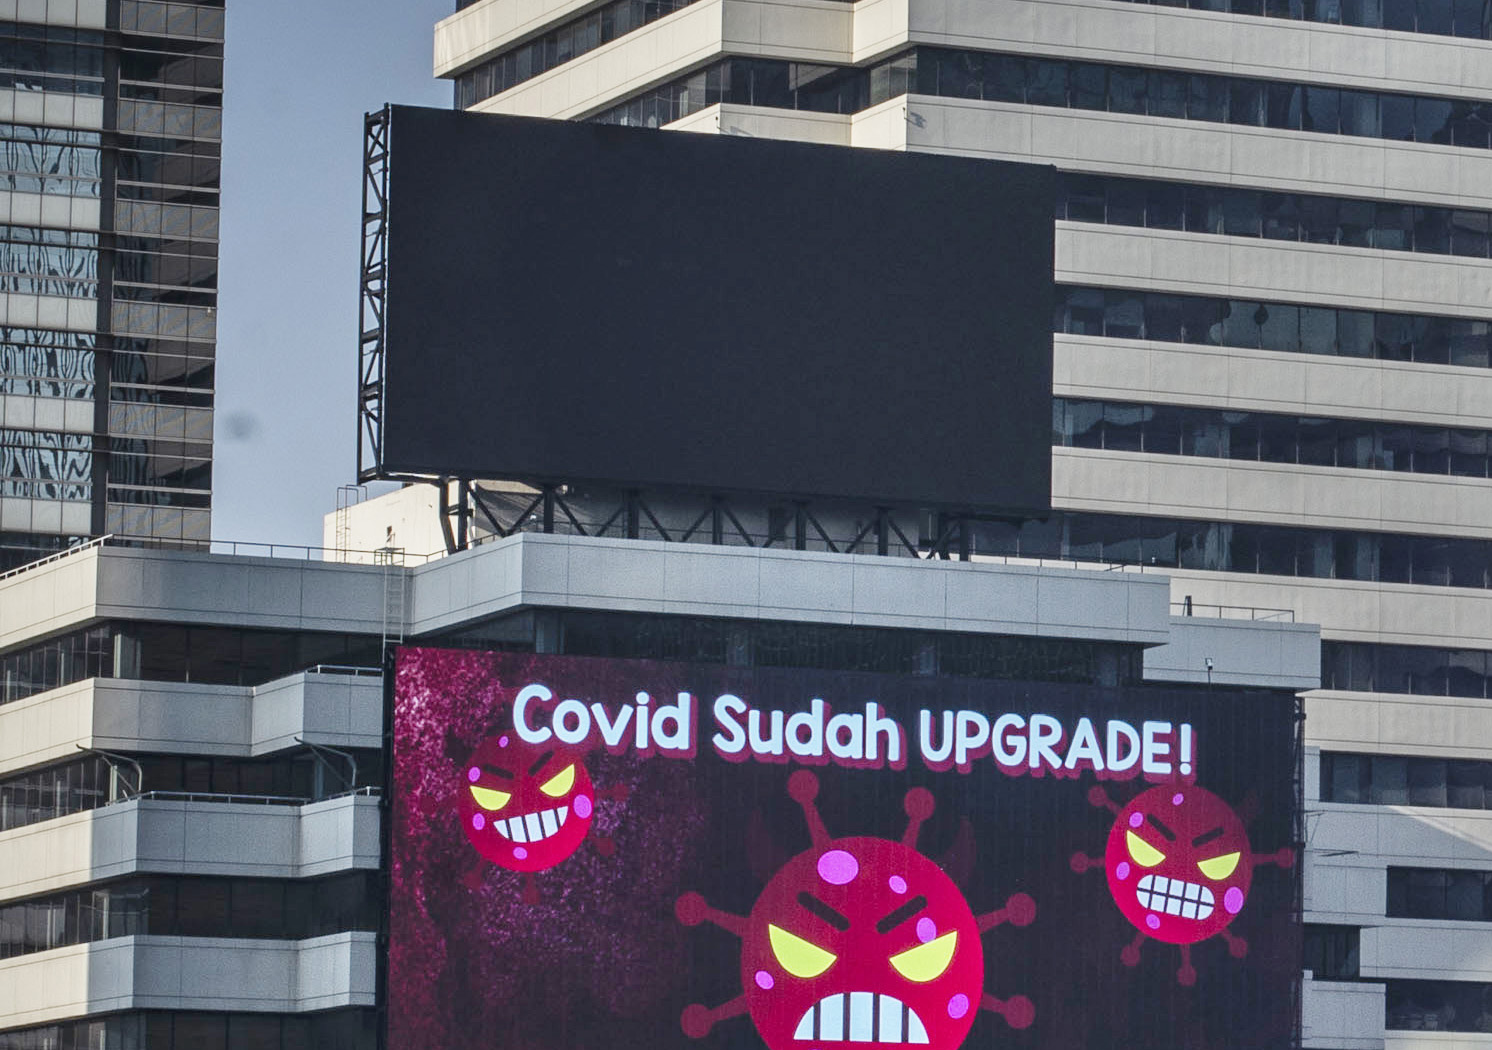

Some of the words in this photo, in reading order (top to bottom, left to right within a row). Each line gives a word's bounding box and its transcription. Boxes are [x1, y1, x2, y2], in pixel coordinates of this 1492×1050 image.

[512, 684, 691, 750] Covid
[712, 694, 900, 762] Sudah
[920, 709, 1193, 776] UPGRADE!
